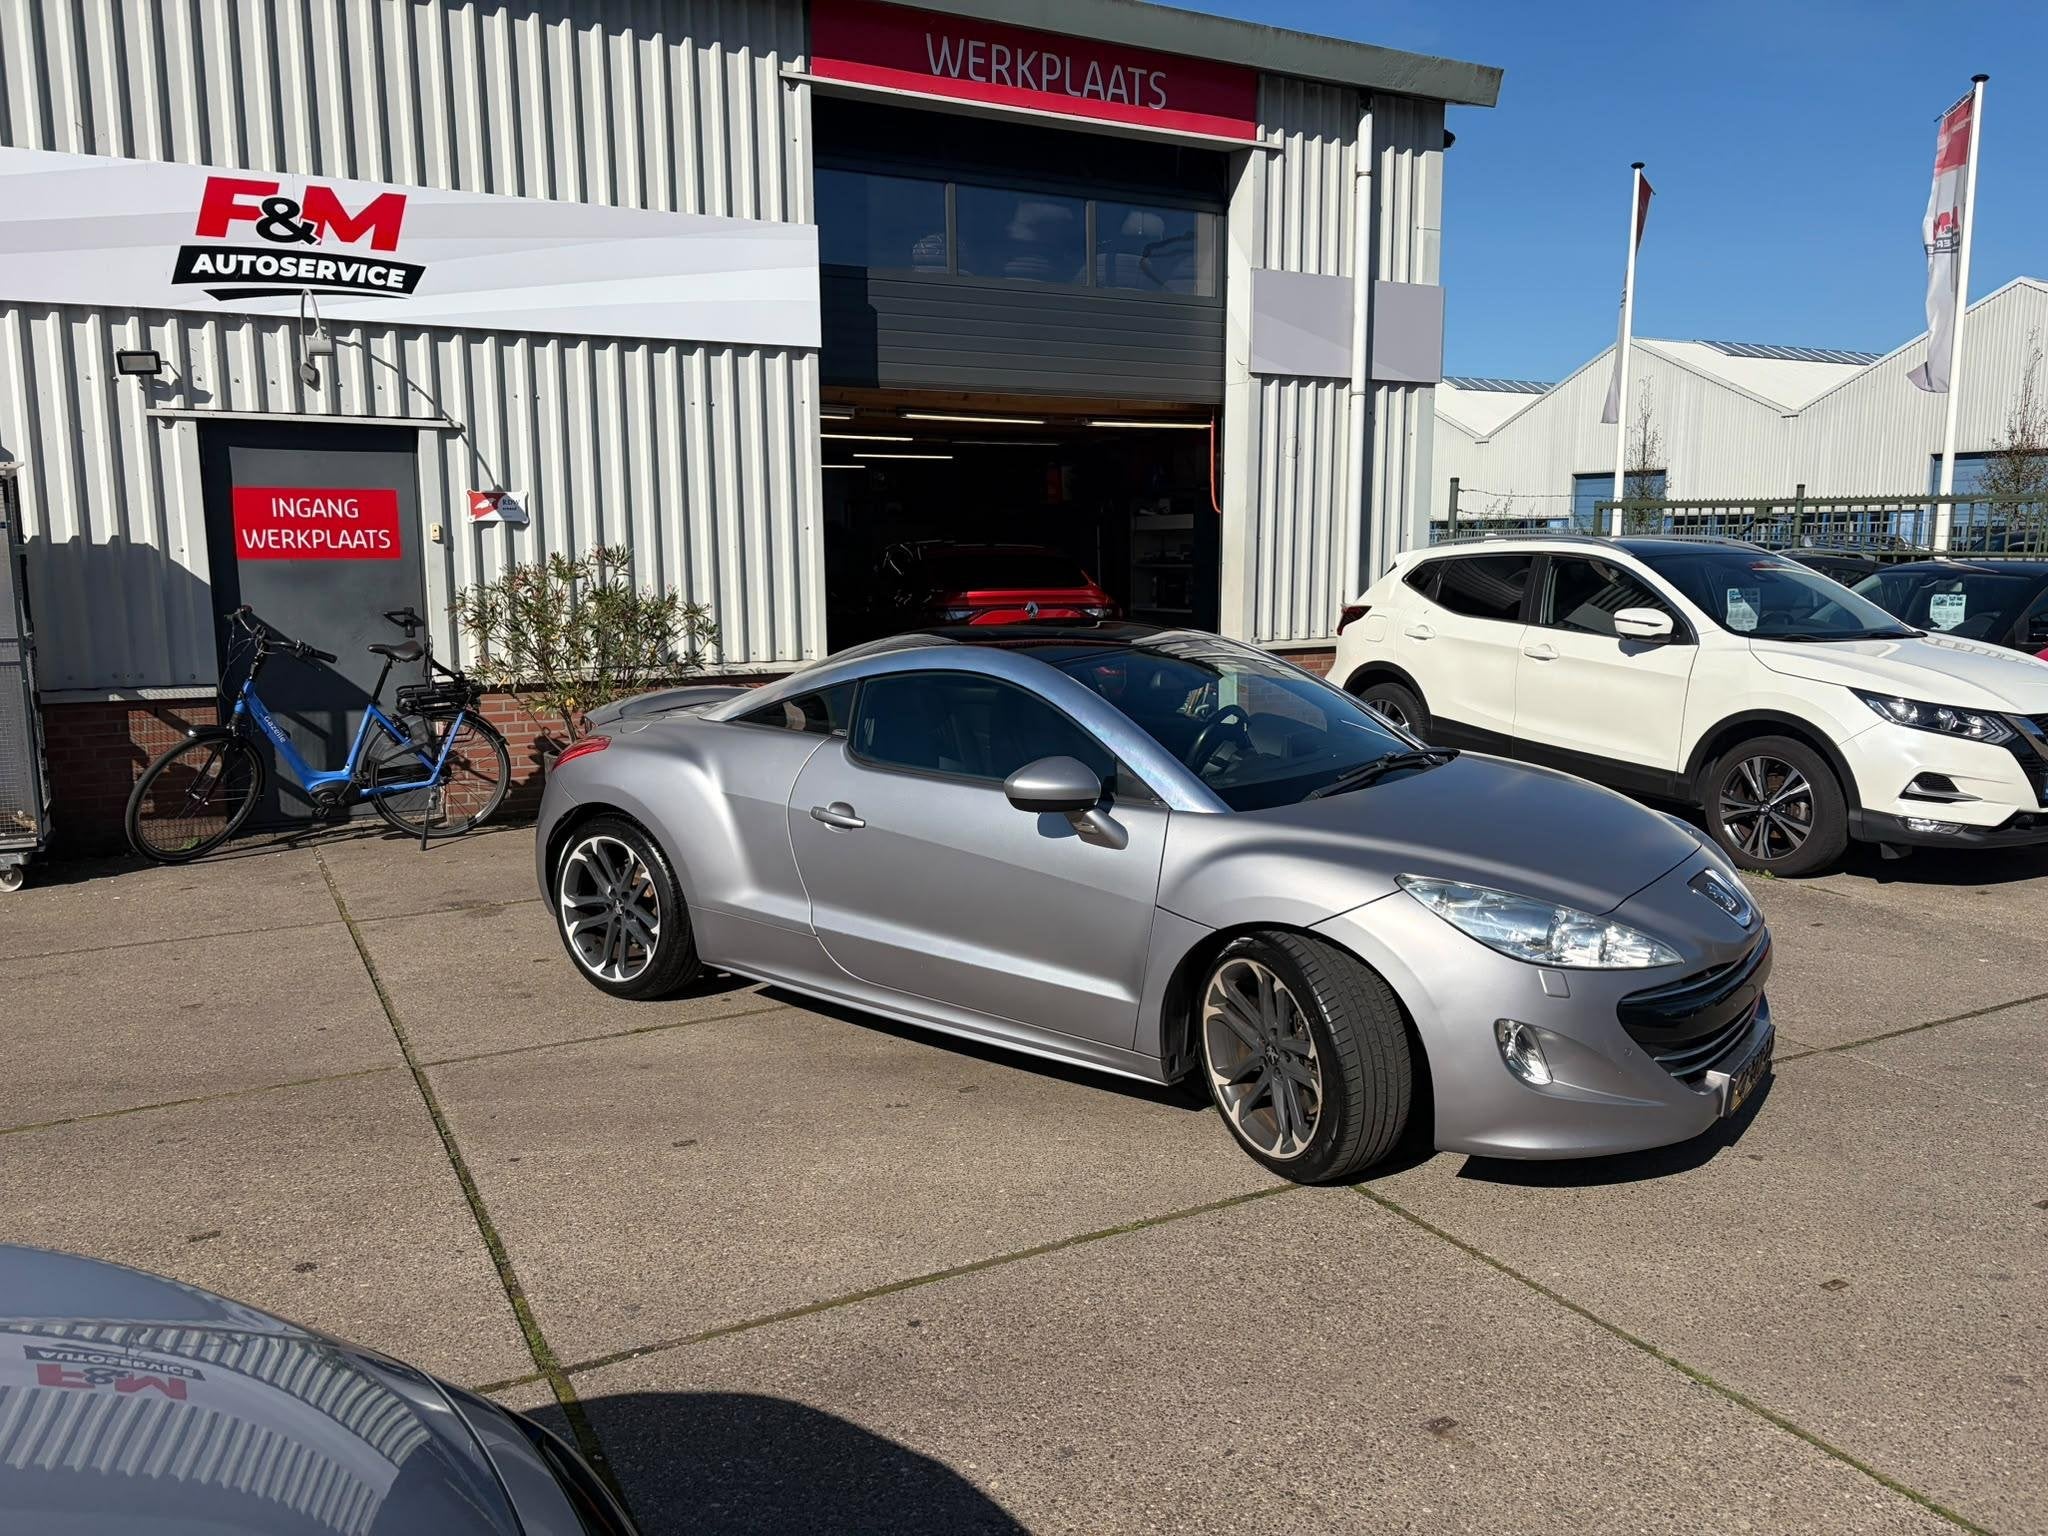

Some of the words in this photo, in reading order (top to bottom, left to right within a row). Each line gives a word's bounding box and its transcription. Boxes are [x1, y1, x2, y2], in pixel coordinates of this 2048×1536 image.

[925, 33, 1167, 110] WERKPLAATS
[195, 176, 407, 252] F&M
[191, 253, 406, 289] AUTOSERVICE
[271, 497, 359, 519] INGANG
[242, 528, 391, 549] WERKPLAATS
